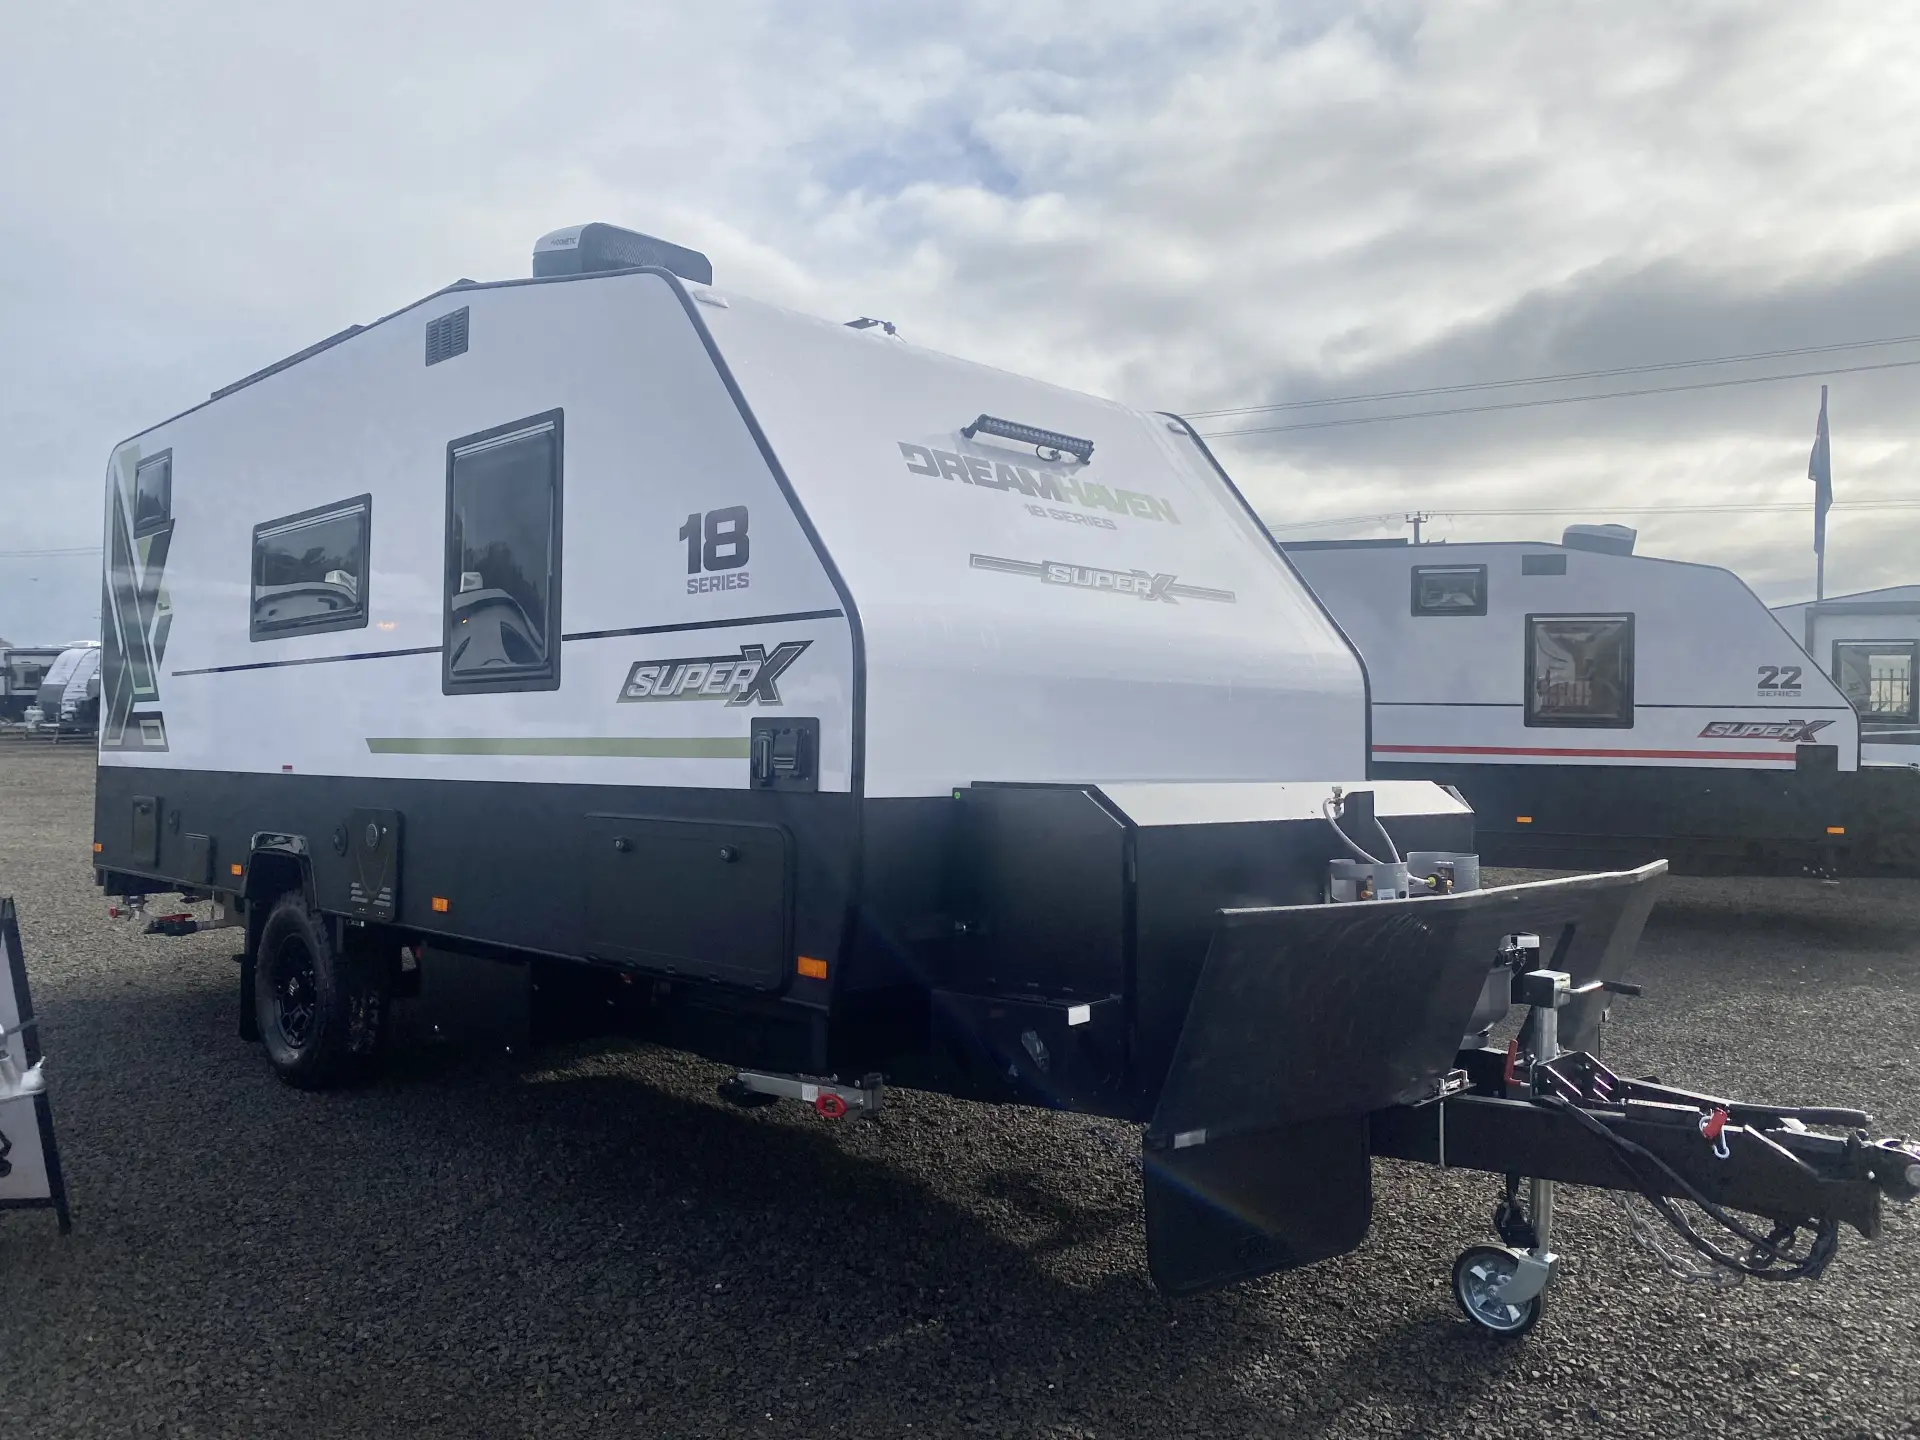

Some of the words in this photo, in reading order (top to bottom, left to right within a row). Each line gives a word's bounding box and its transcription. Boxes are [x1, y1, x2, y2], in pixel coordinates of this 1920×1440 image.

[897, 441, 1181, 525] DREAMHAVEN
[1024, 504, 1047, 518] 18
[1051, 509, 1117, 530] SERIES
[679, 505, 749, 574] 18
[687, 572, 749, 594] SERIES
[1757, 666, 1802, 689] 22
